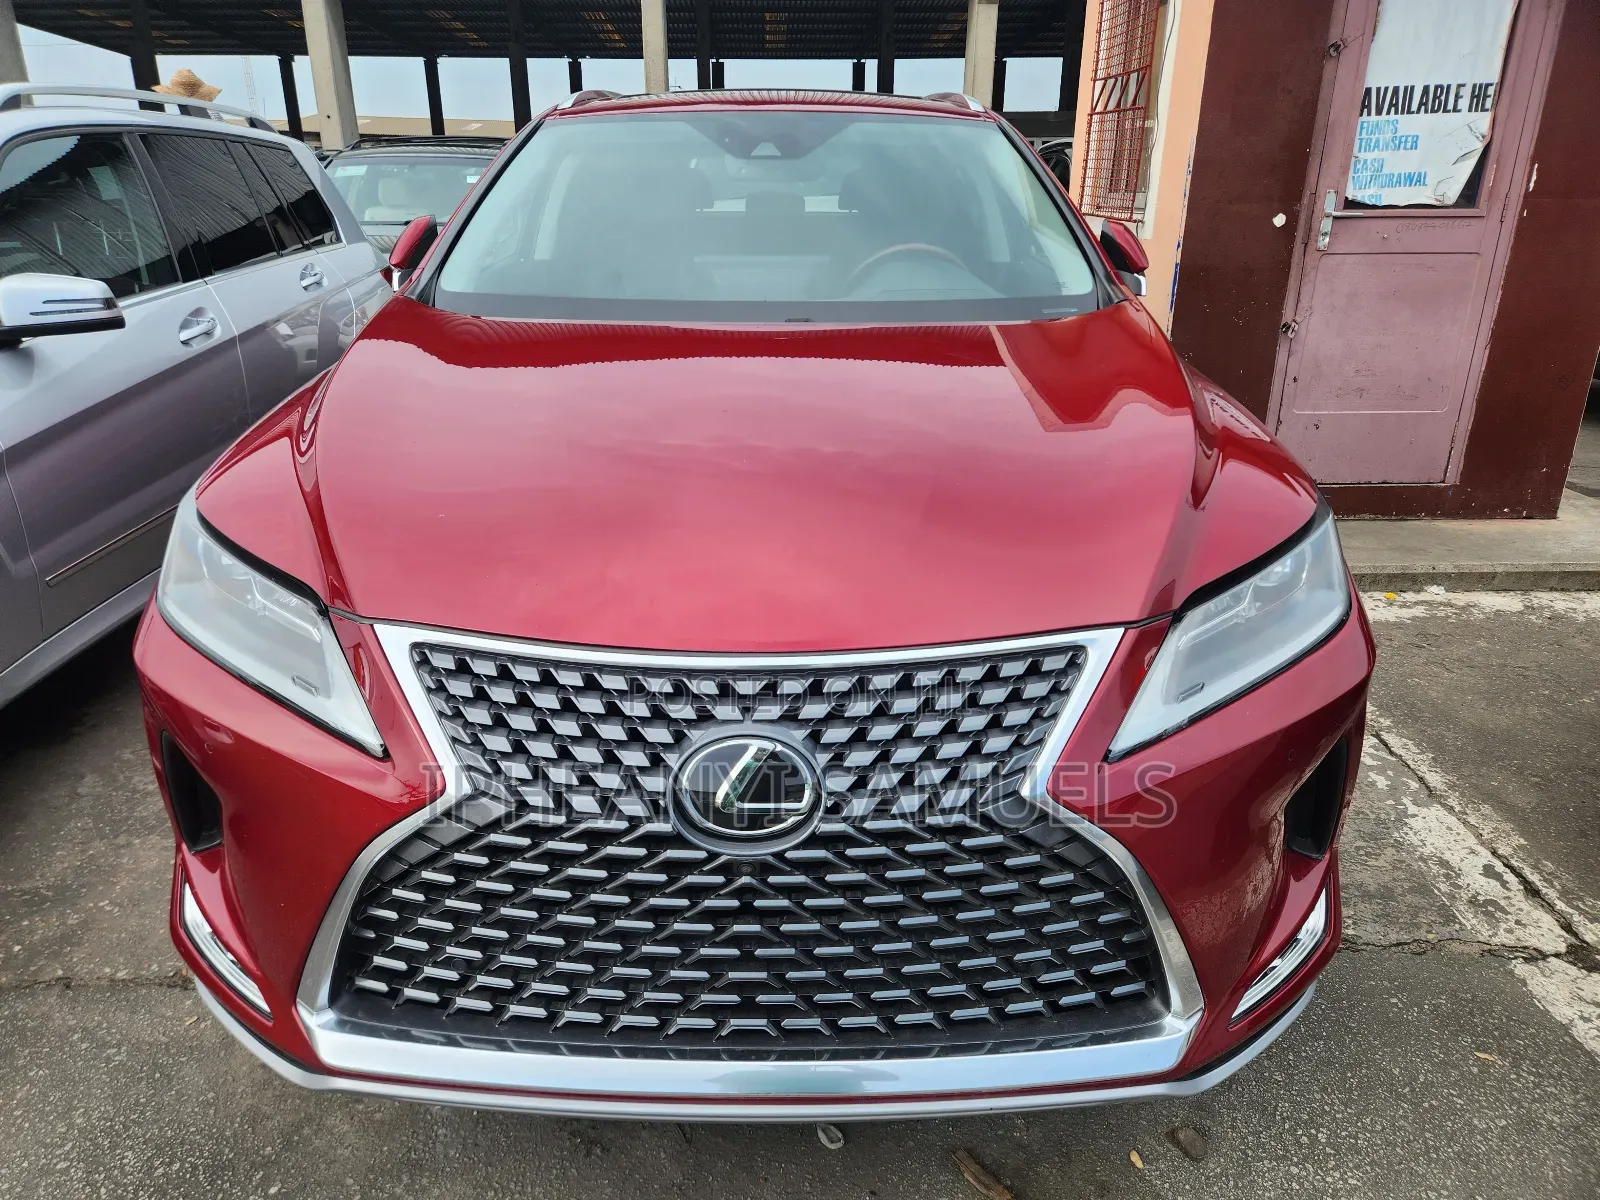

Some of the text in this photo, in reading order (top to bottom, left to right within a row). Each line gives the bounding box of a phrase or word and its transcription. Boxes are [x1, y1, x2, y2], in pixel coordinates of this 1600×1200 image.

[1359, 83, 1466, 117] AVAILABLE
[1359, 119, 1399, 137] FUNDS
[1357, 134, 1420, 153] TRANSFER
[1352, 158, 1385, 175] CASH
[1351, 171, 1429, 190] WITHDRAWAL
